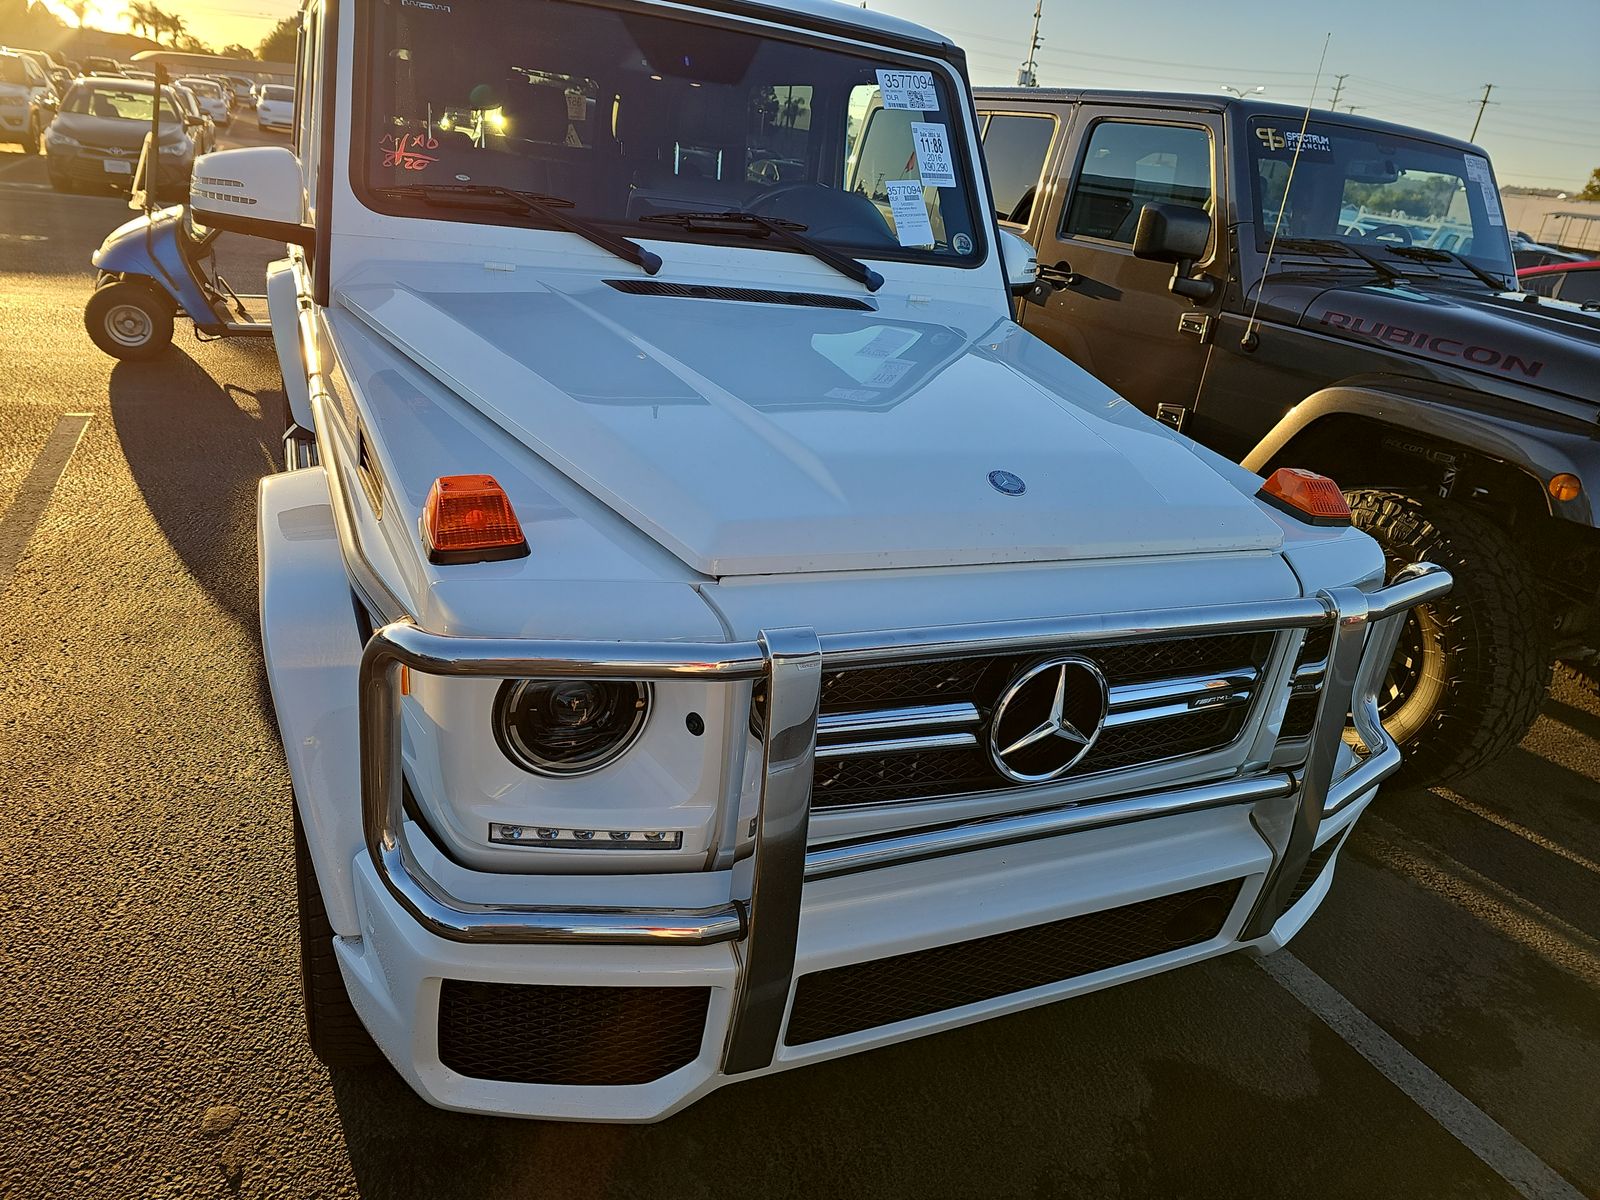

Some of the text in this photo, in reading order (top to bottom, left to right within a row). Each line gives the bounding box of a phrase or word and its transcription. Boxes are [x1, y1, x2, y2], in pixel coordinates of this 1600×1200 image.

[884, 74, 935, 89] 3577094
[1286, 132, 1330, 145] SPECTRUM
[920, 138, 944, 154] 11:88
[1288, 141, 1331, 152] FINANCIAL
[927, 154, 943, 162] 2016
[887, 185, 921, 196] 3577094
[1320, 310, 1544, 378] RUBICON
